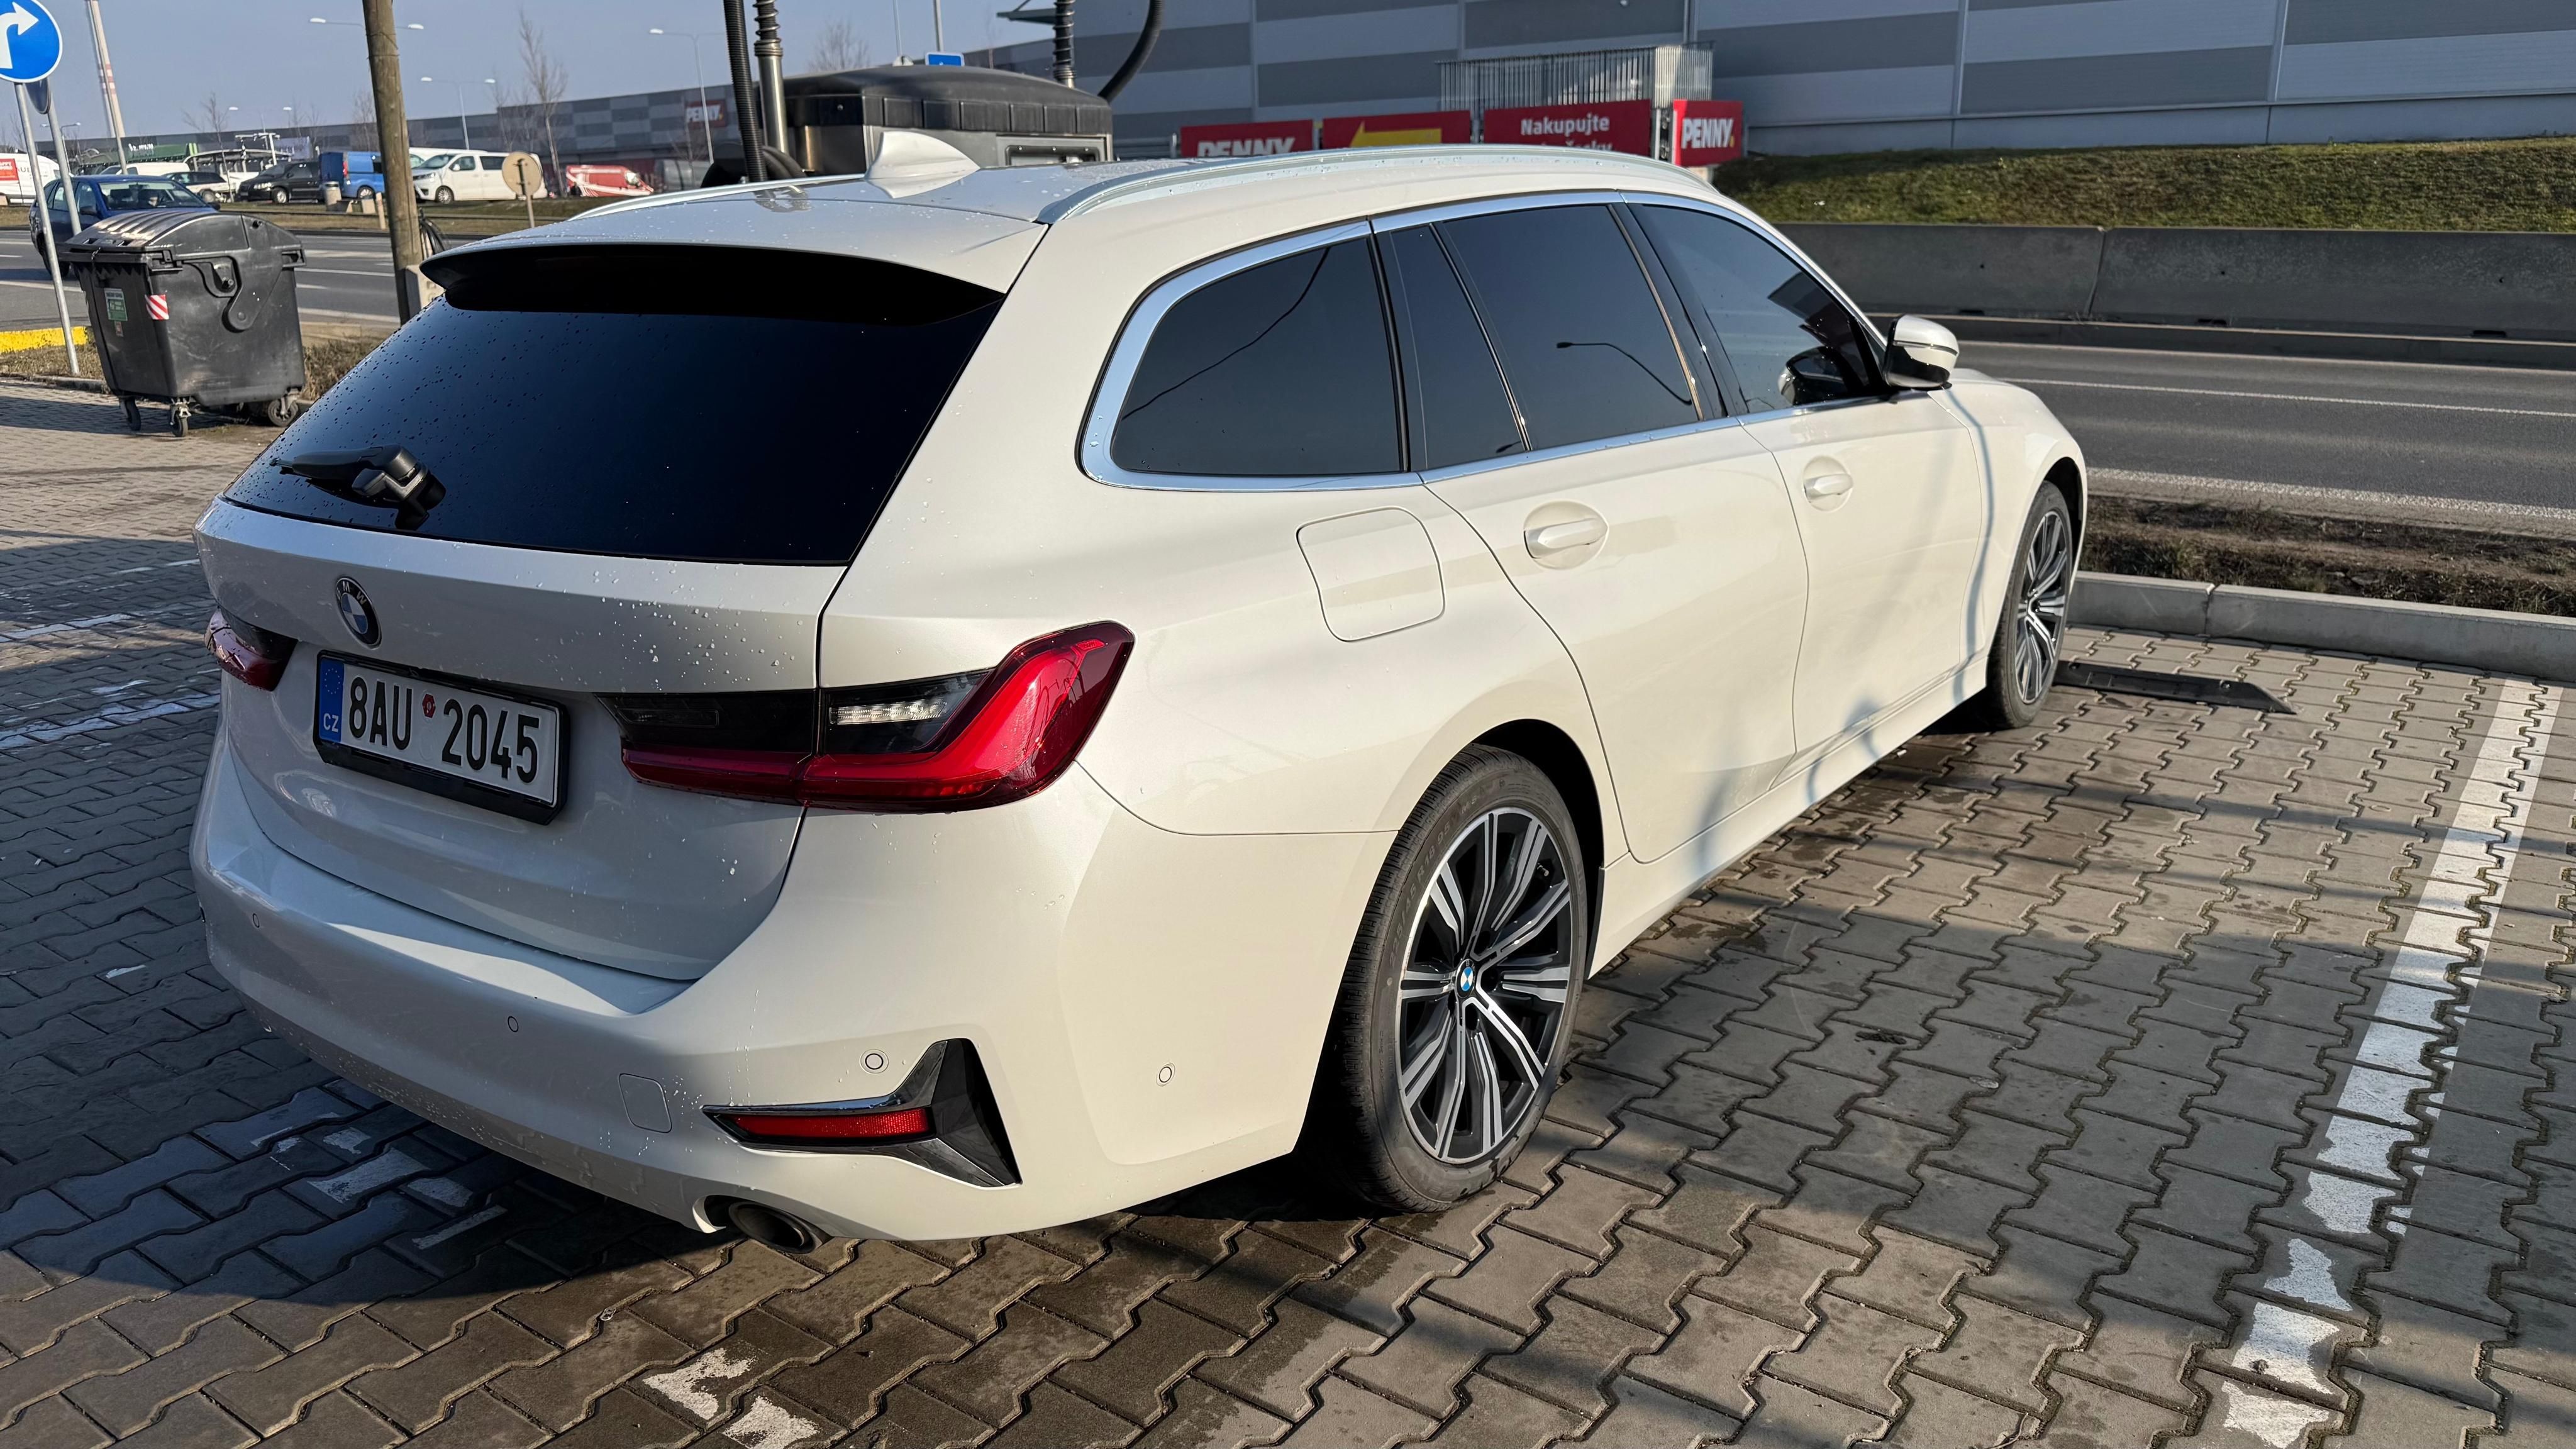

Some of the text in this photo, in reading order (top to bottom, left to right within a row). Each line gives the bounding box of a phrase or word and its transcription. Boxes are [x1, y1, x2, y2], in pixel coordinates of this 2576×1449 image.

[1520, 113, 1610, 137] Nakupujte
[323, 713, 339, 733] CZ
[349, 677, 540, 784] 8AU 2045
